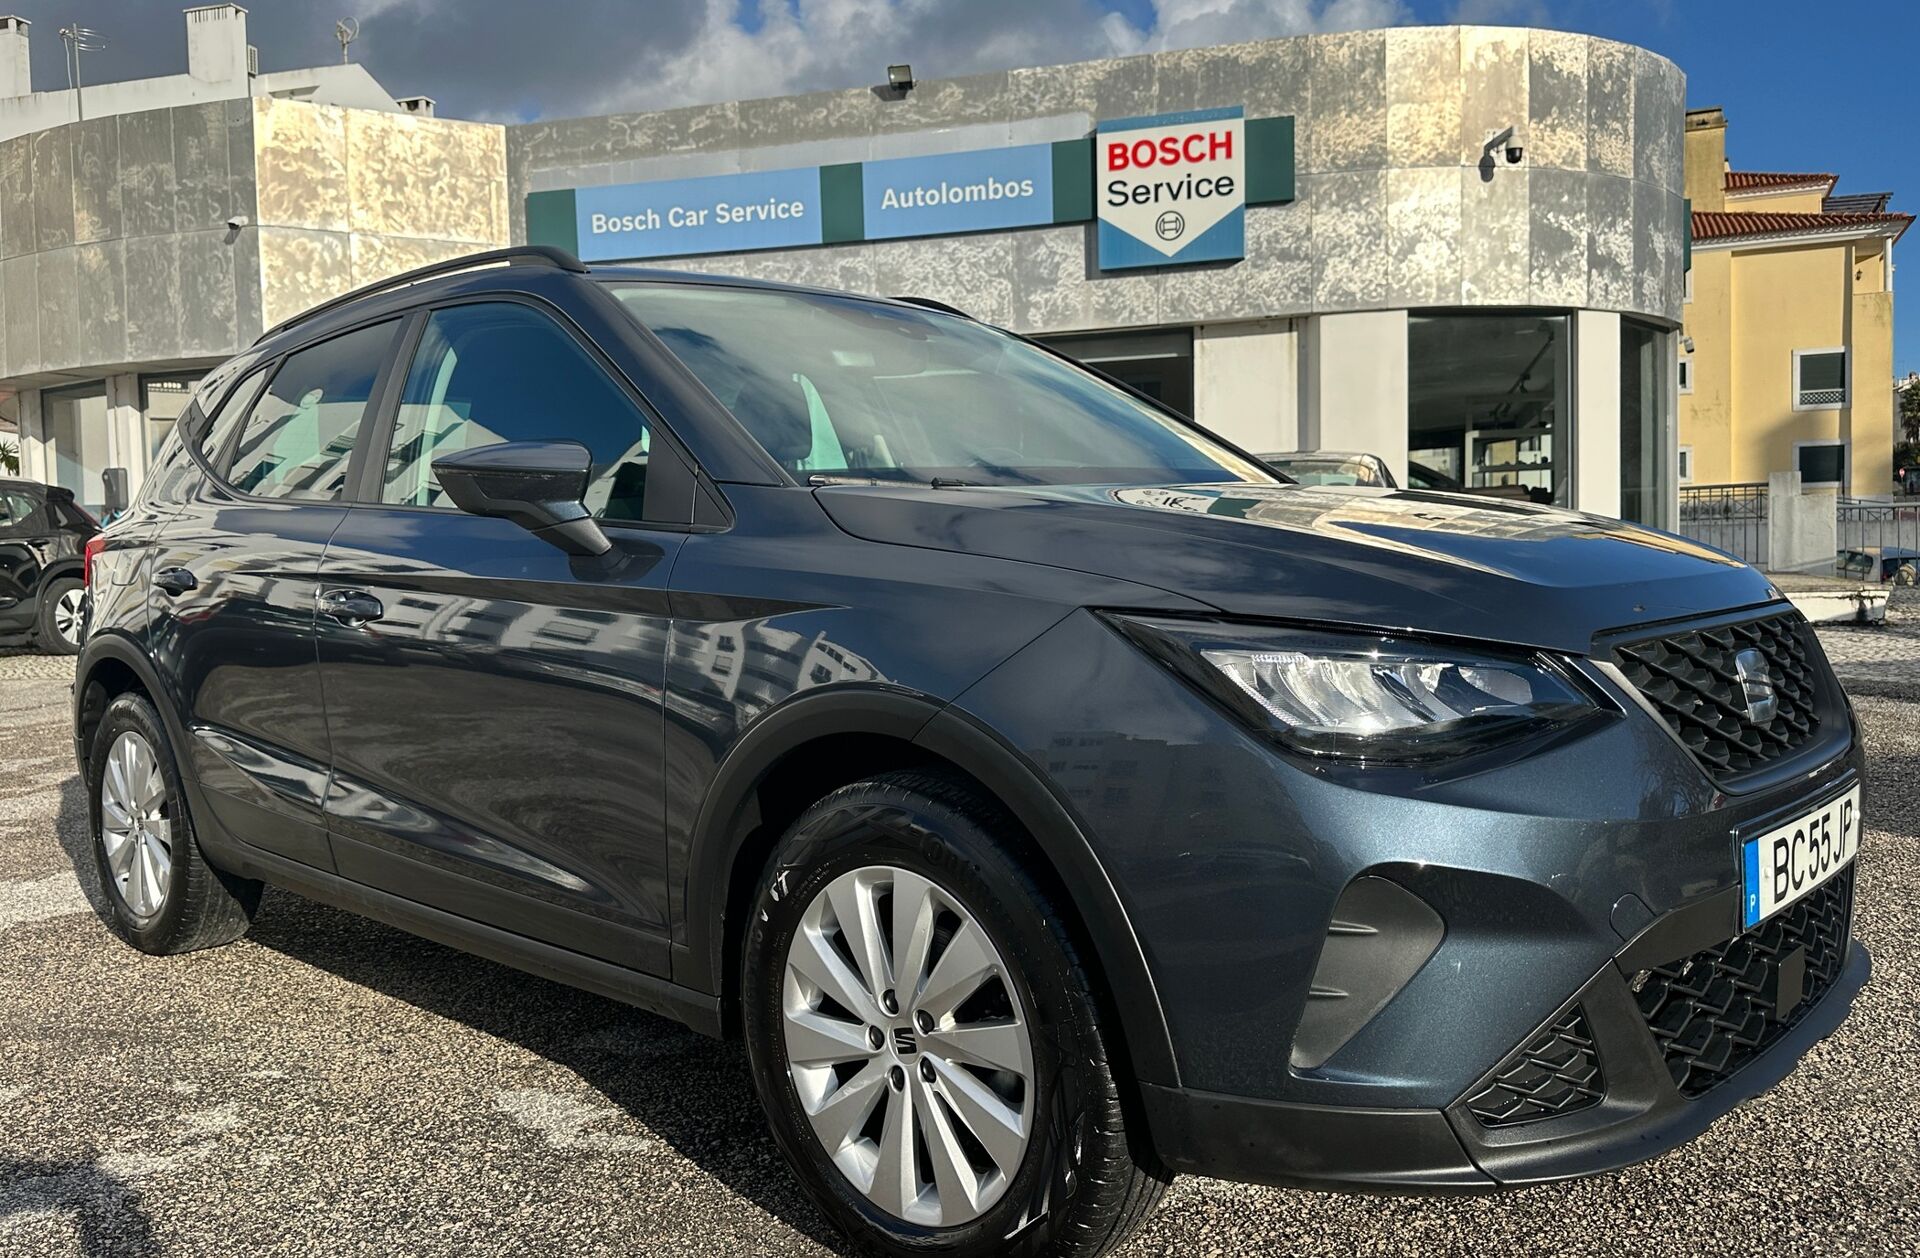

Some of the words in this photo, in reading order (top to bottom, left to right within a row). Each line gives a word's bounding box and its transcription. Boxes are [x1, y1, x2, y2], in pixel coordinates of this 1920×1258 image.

[1108, 131, 1232, 171] BOSCH
[881, 177, 1034, 210] Autolombos
[1107, 173, 1234, 207] Service
[591, 209, 660, 234] Bosch
[668, 206, 708, 228] Car
[715, 198, 804, 224] Service
